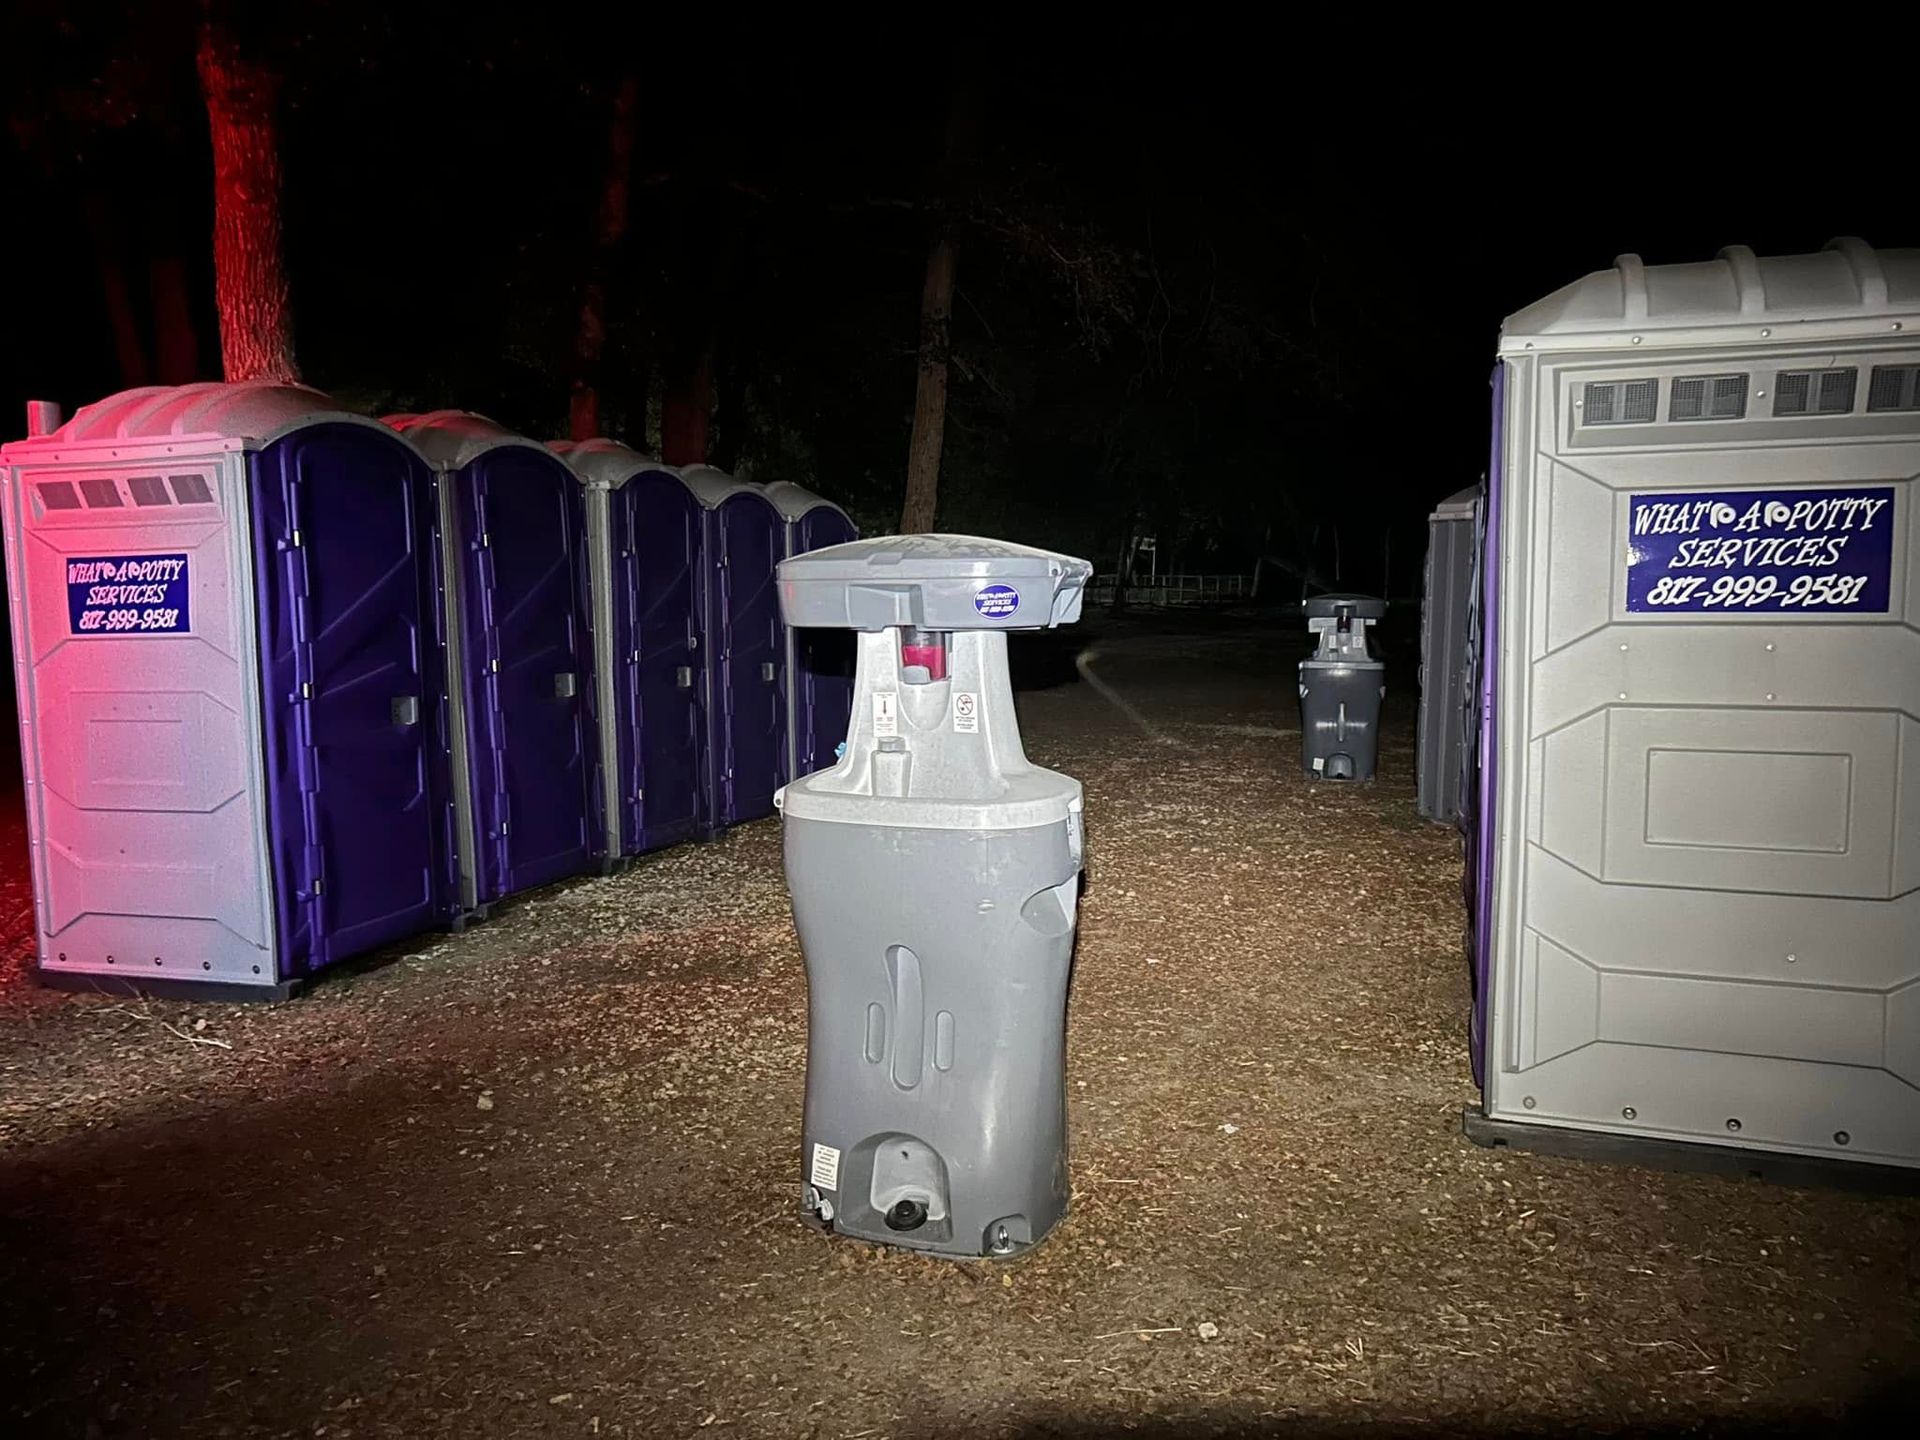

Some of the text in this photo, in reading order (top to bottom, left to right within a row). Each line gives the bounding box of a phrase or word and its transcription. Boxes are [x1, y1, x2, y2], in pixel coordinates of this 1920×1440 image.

[1634, 497, 1888, 535] WHAT A POTTY
[1668, 536, 1849, 569] SERVICES
[68, 558, 186, 584] WHAT A POTTY
[86, 583, 168, 605] SERVICES
[1647, 574, 1868, 607] 817-999-9581
[79, 608, 179, 630] 817-999-9581
